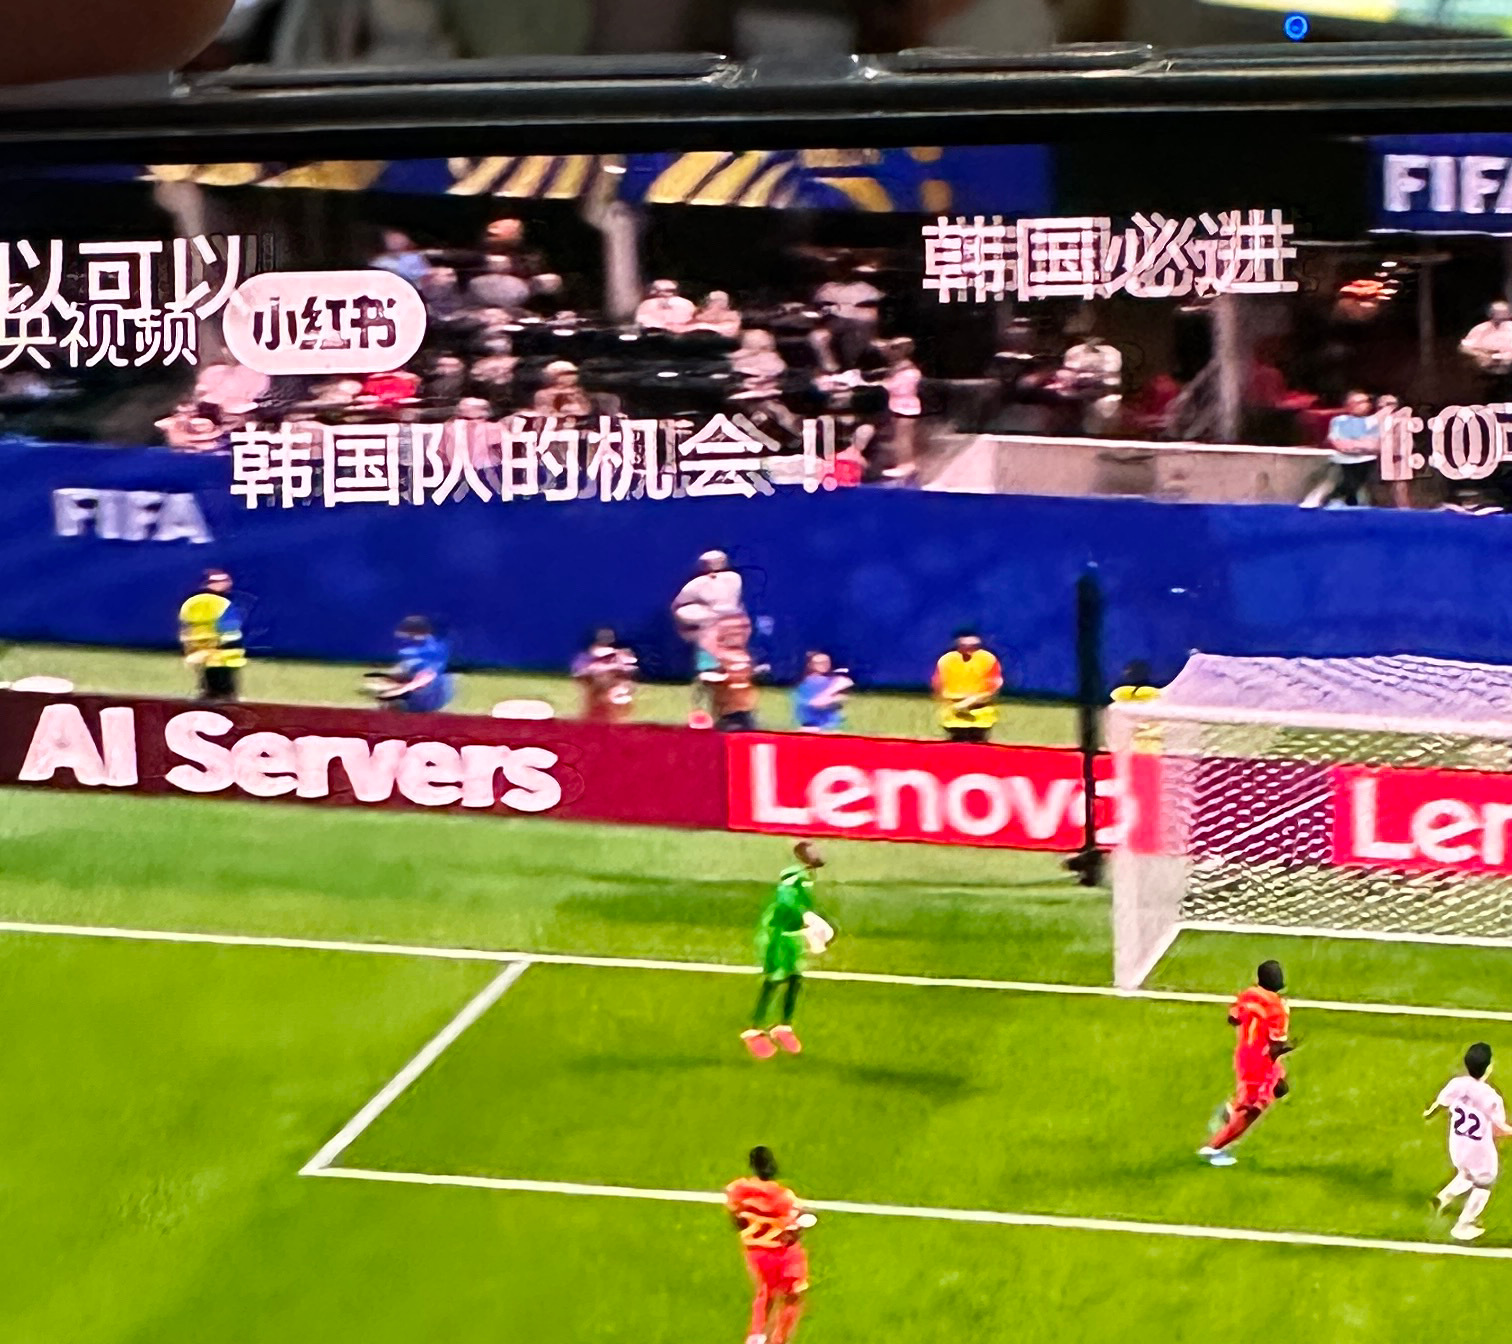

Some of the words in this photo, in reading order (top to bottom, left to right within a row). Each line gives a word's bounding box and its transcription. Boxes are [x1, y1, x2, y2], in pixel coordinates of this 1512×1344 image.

[922, 209, 1298, 303] 韩国必进
[252, 295, 397, 351] 小红书
[53, 487, 214, 544] FIFA
[18, 703, 138, 787] AI
[163, 711, 562, 812] Servers
[749, 744, 1138, 845] Lenovo
[1453, 1107, 1483, 1141] 22
